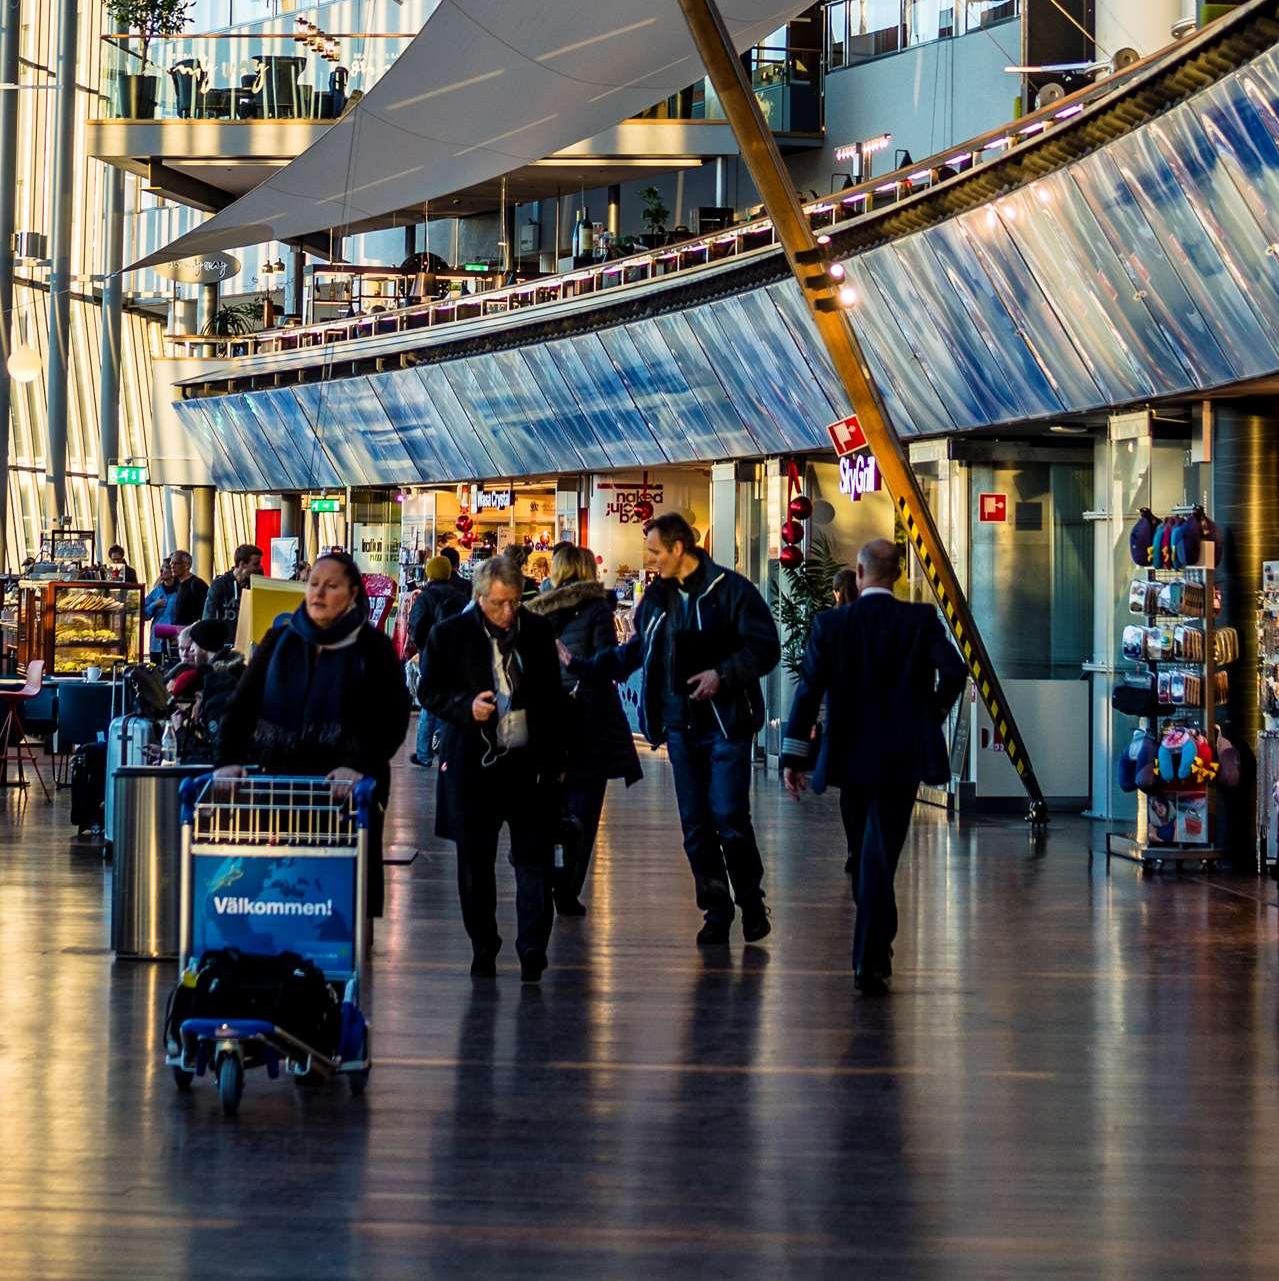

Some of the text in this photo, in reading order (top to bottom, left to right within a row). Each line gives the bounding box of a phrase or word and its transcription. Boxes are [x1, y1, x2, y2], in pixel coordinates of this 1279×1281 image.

[839, 455, 876, 502] SkyGrill
[477, 490, 491, 507] Wasa
[491, 490, 510, 510] Crystal
[616, 490, 663, 503] naked
[606, 503, 635, 516] juic
[214, 896, 332, 917] Välkommen!
